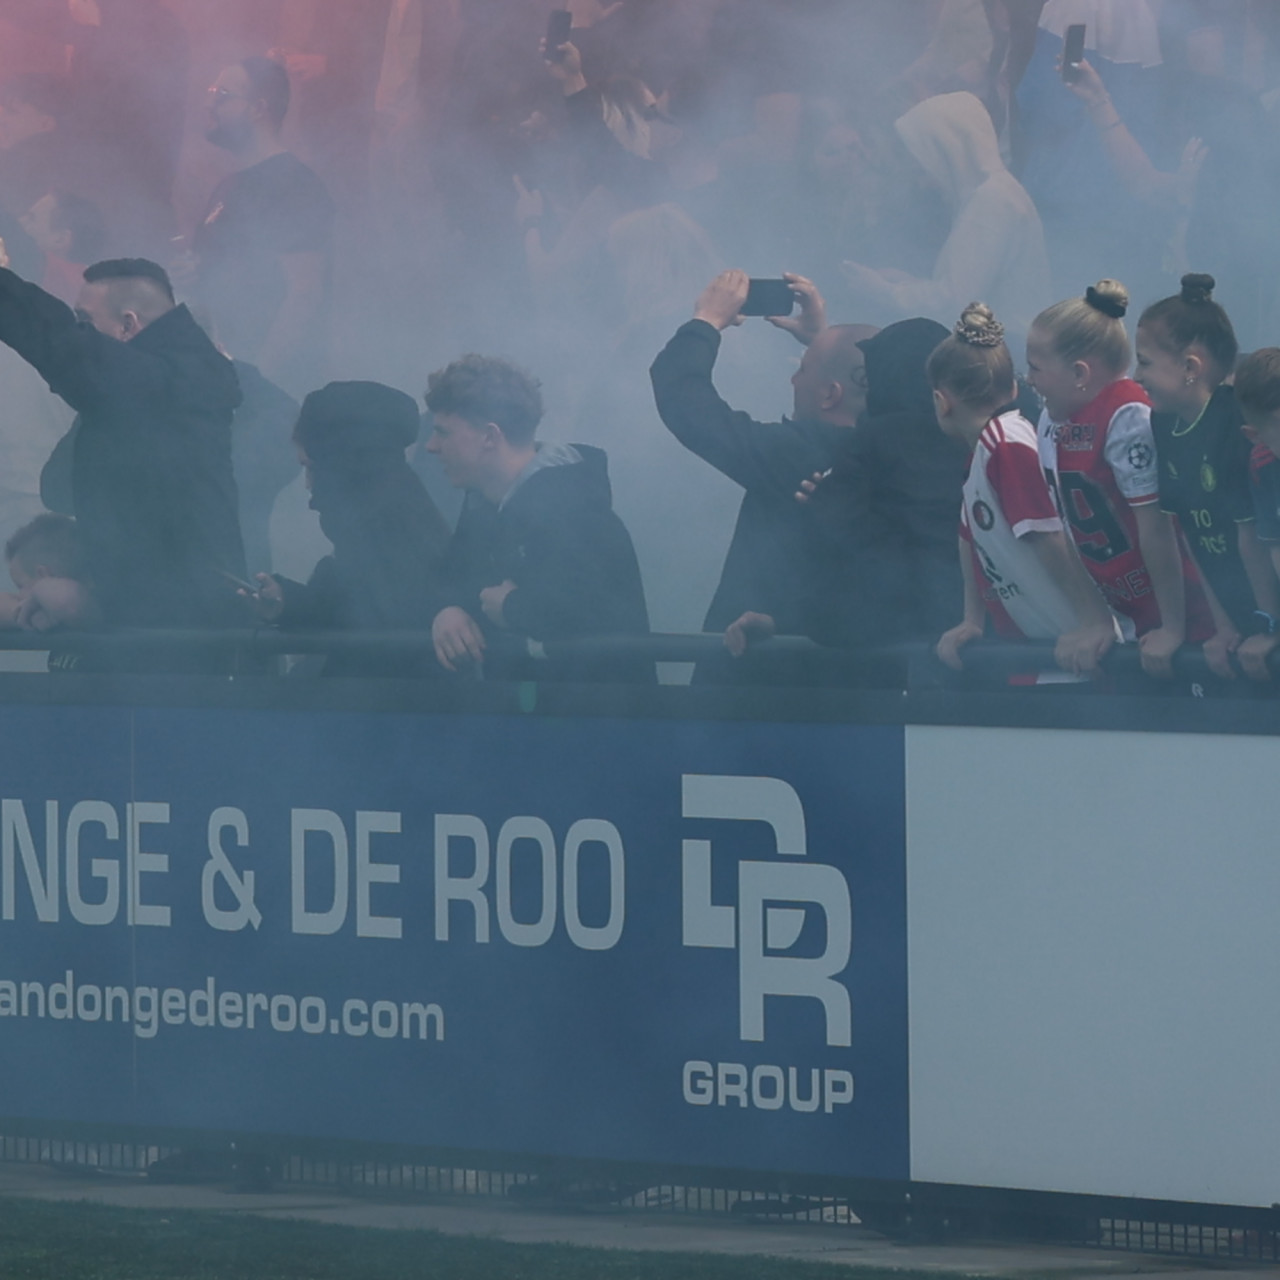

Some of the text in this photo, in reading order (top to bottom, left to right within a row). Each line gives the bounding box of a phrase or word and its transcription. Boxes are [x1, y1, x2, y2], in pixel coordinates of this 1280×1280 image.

[201, 806, 263, 932] &
[290, 807, 403, 940] DE
[433, 813, 625, 951] ROO
[682, 1059, 855, 1114] GROUP
